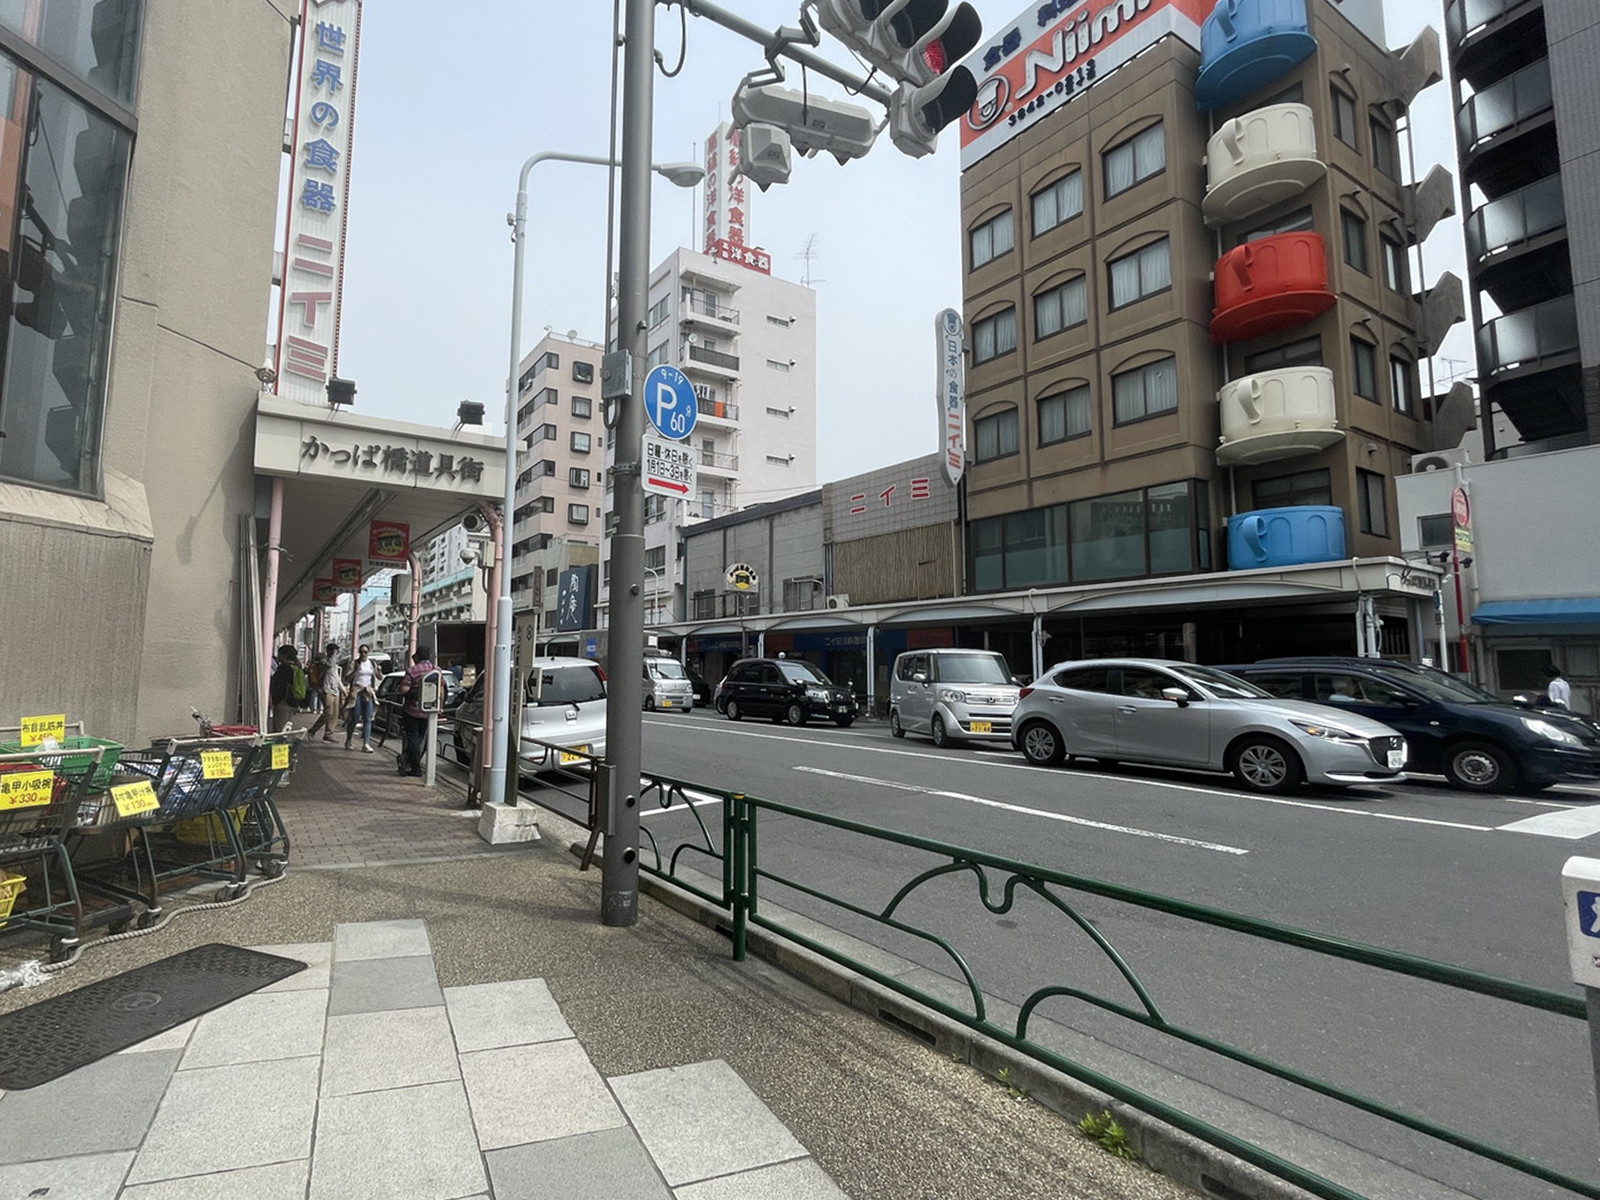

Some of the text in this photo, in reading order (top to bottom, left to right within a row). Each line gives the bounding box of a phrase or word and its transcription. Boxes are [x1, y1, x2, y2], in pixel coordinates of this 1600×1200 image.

[1015, 0, 1150, 100] Niim
[286, 20, 347, 382] 世界の食器 ニイミ
[660, 368, 685, 385] 9-19
[656, 382, 678, 427] P
[301, 435, 485, 483] かっぱ橋道具街
[850, 477, 931, 515] ニイミ
